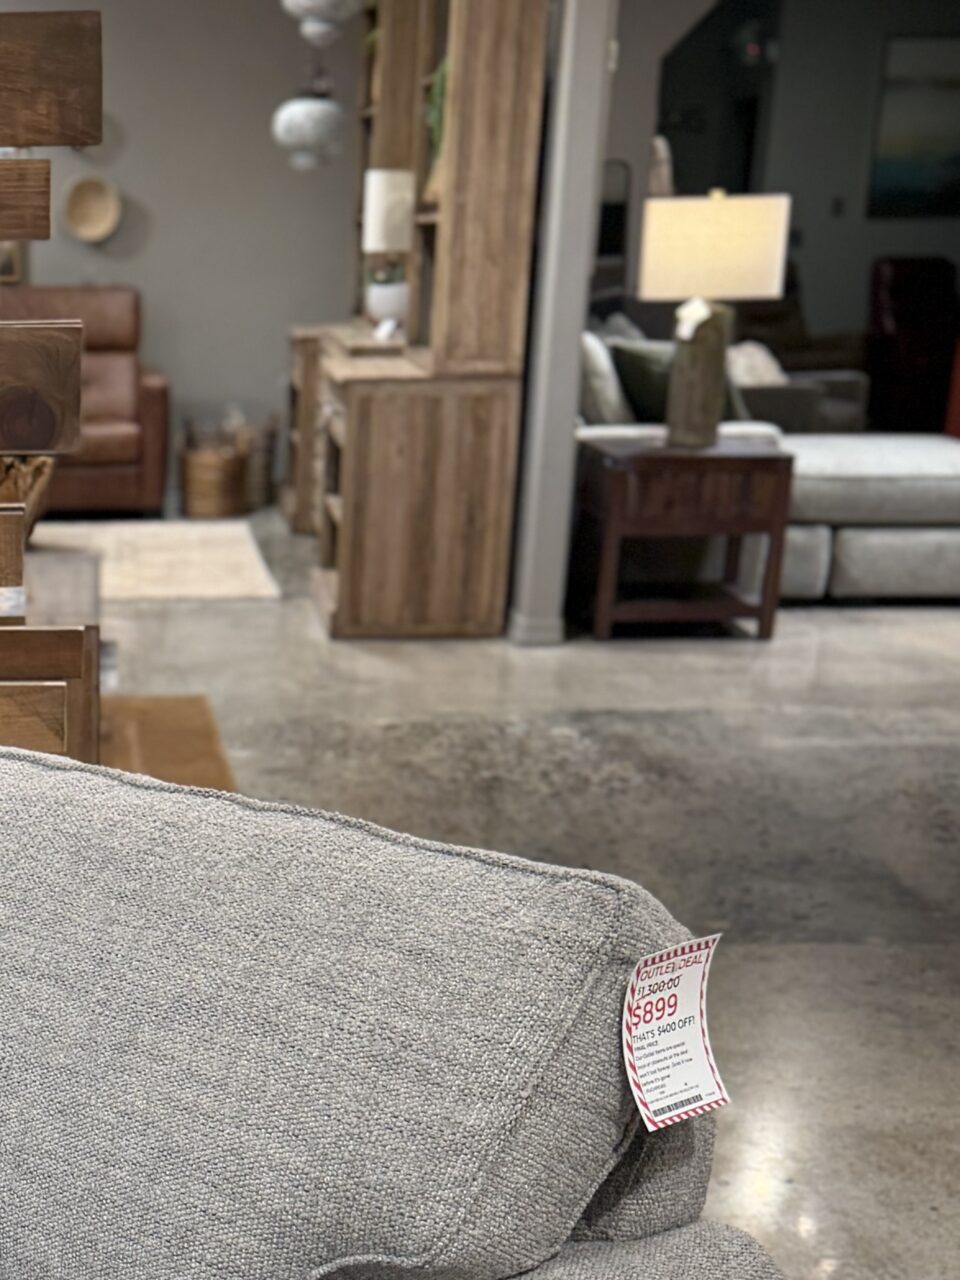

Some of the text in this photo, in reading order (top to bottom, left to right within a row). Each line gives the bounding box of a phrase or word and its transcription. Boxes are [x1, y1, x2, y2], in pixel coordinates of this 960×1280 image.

[640, 954, 703, 981] OUTLET DEAL
[631, 993, 678, 1030] $899
[657, 1021, 676, 1037] $400
